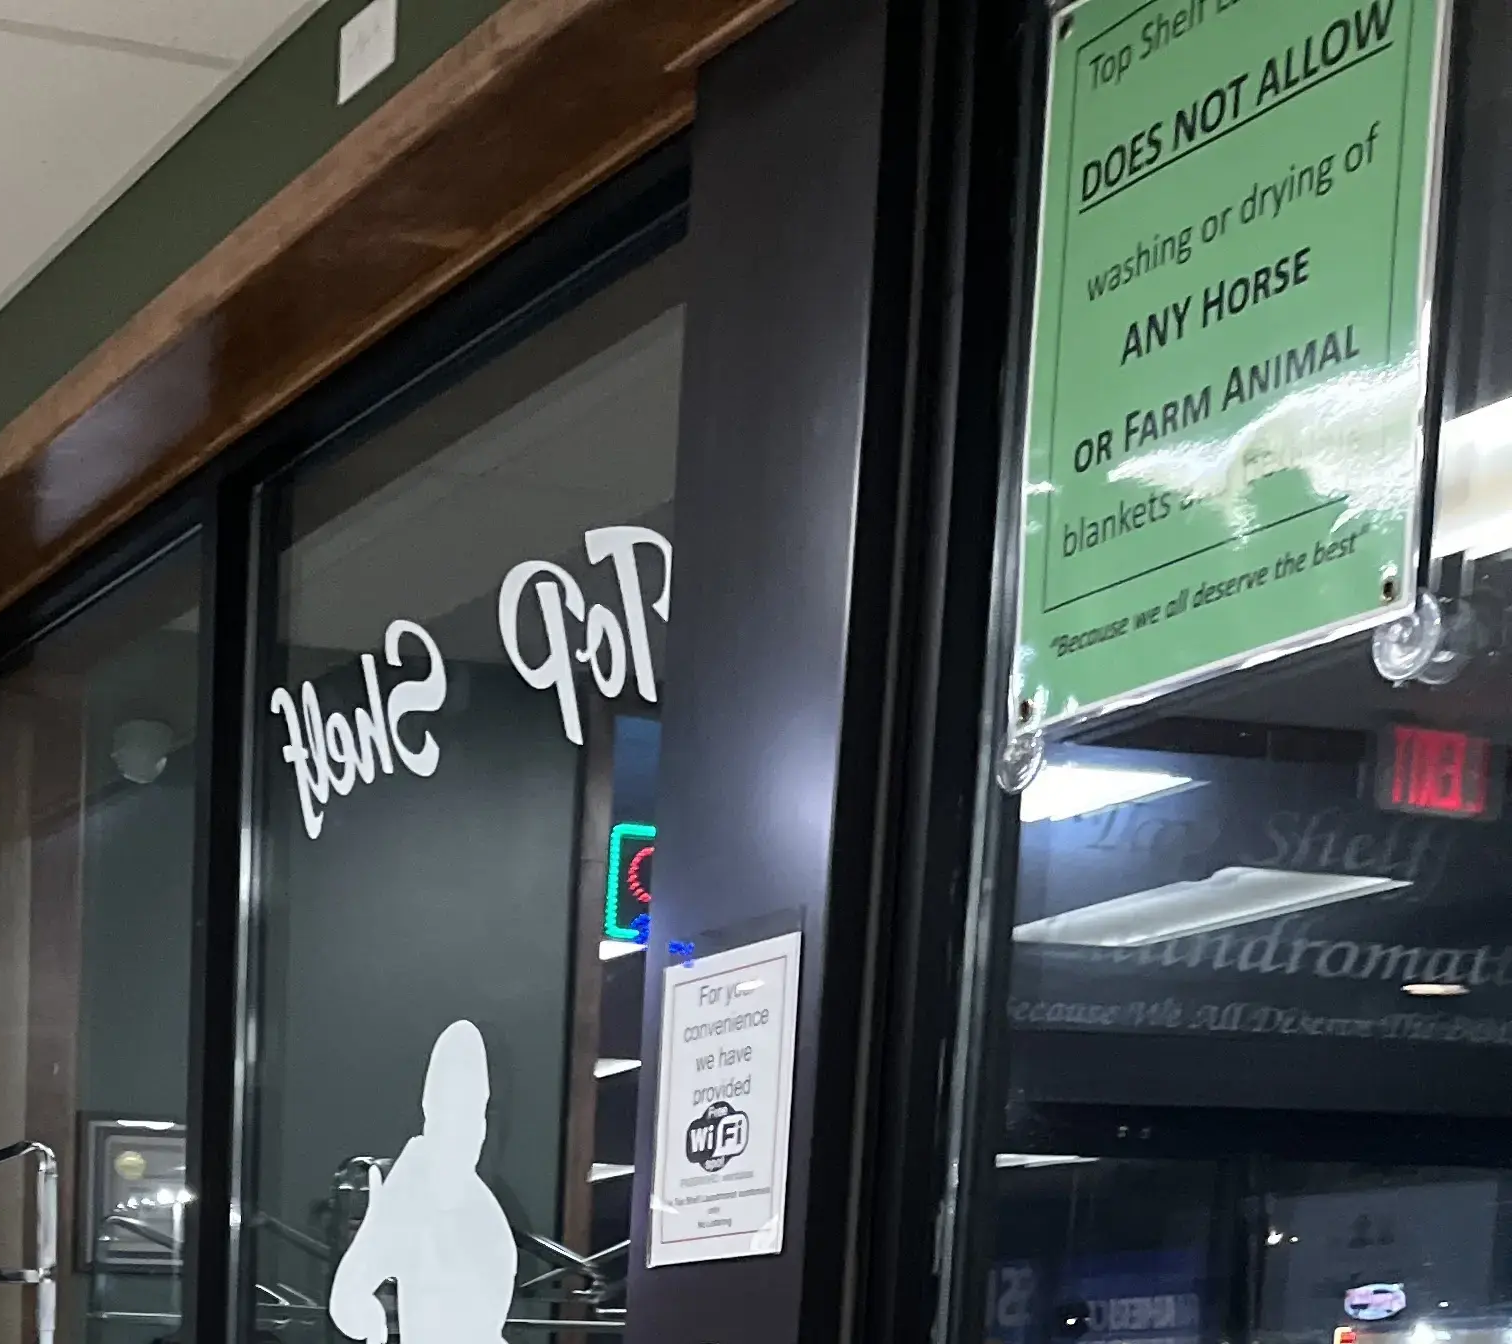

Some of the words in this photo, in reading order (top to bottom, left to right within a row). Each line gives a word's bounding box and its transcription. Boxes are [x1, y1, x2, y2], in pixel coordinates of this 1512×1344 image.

[1081, 122, 1164, 204] DOES
[1173, 74, 1249, 152] NOT
[1255, 0, 1396, 106] ALLOW
[1088, 45, 1134, 90] Top
[1087, 224, 1193, 302] washing
[1199, 203, 1232, 246] or
[1240, 153, 1334, 227] drying
[1344, 121, 1381, 183] of
[1120, 296, 1191, 366] ANY
[1201, 246, 1313, 329] HORSE
[1124, 383, 1213, 452] FARM
[1221, 324, 1361, 406] ANIMAL
[1062, 488, 1172, 559] blankets
[1135, 603, 1162, 631] we
[1164, 588, 1189, 621] all
[1193, 570, 1270, 610] deserve
[1275, 550, 1307, 581] the
[683, 1008, 770, 1044] convenience
[695, 1051, 715, 1072] we
[717, 1043, 752, 1069] have
[692, 1074, 752, 1107] provided
